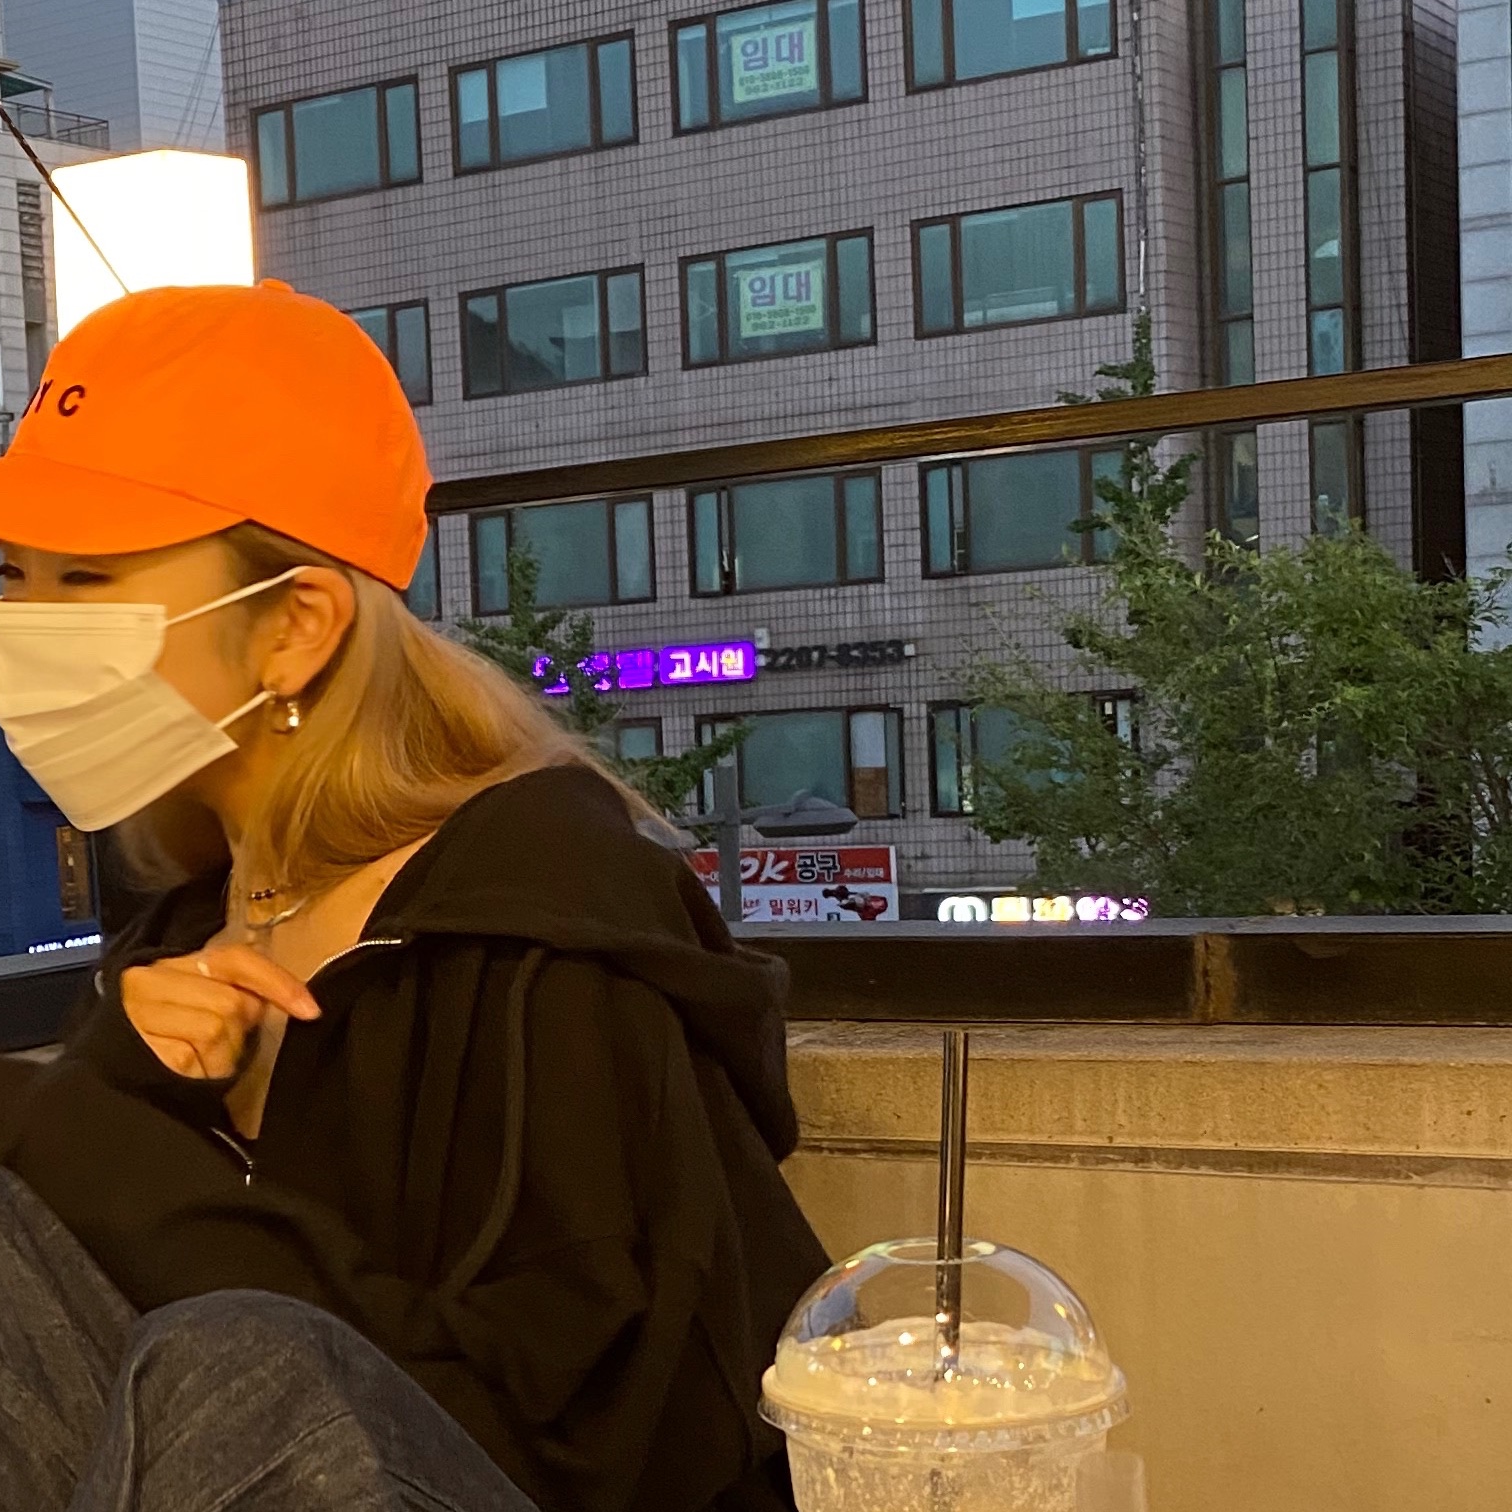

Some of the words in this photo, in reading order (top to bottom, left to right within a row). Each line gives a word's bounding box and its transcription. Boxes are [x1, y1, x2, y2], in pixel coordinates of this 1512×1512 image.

[741, 30, 804, 72] 임대
[748, 269, 812, 308] 임대
[668, 647, 746, 681] 고시원
[795, 852, 841, 883] 공구
[769, 897, 819, 917] 밀워키
